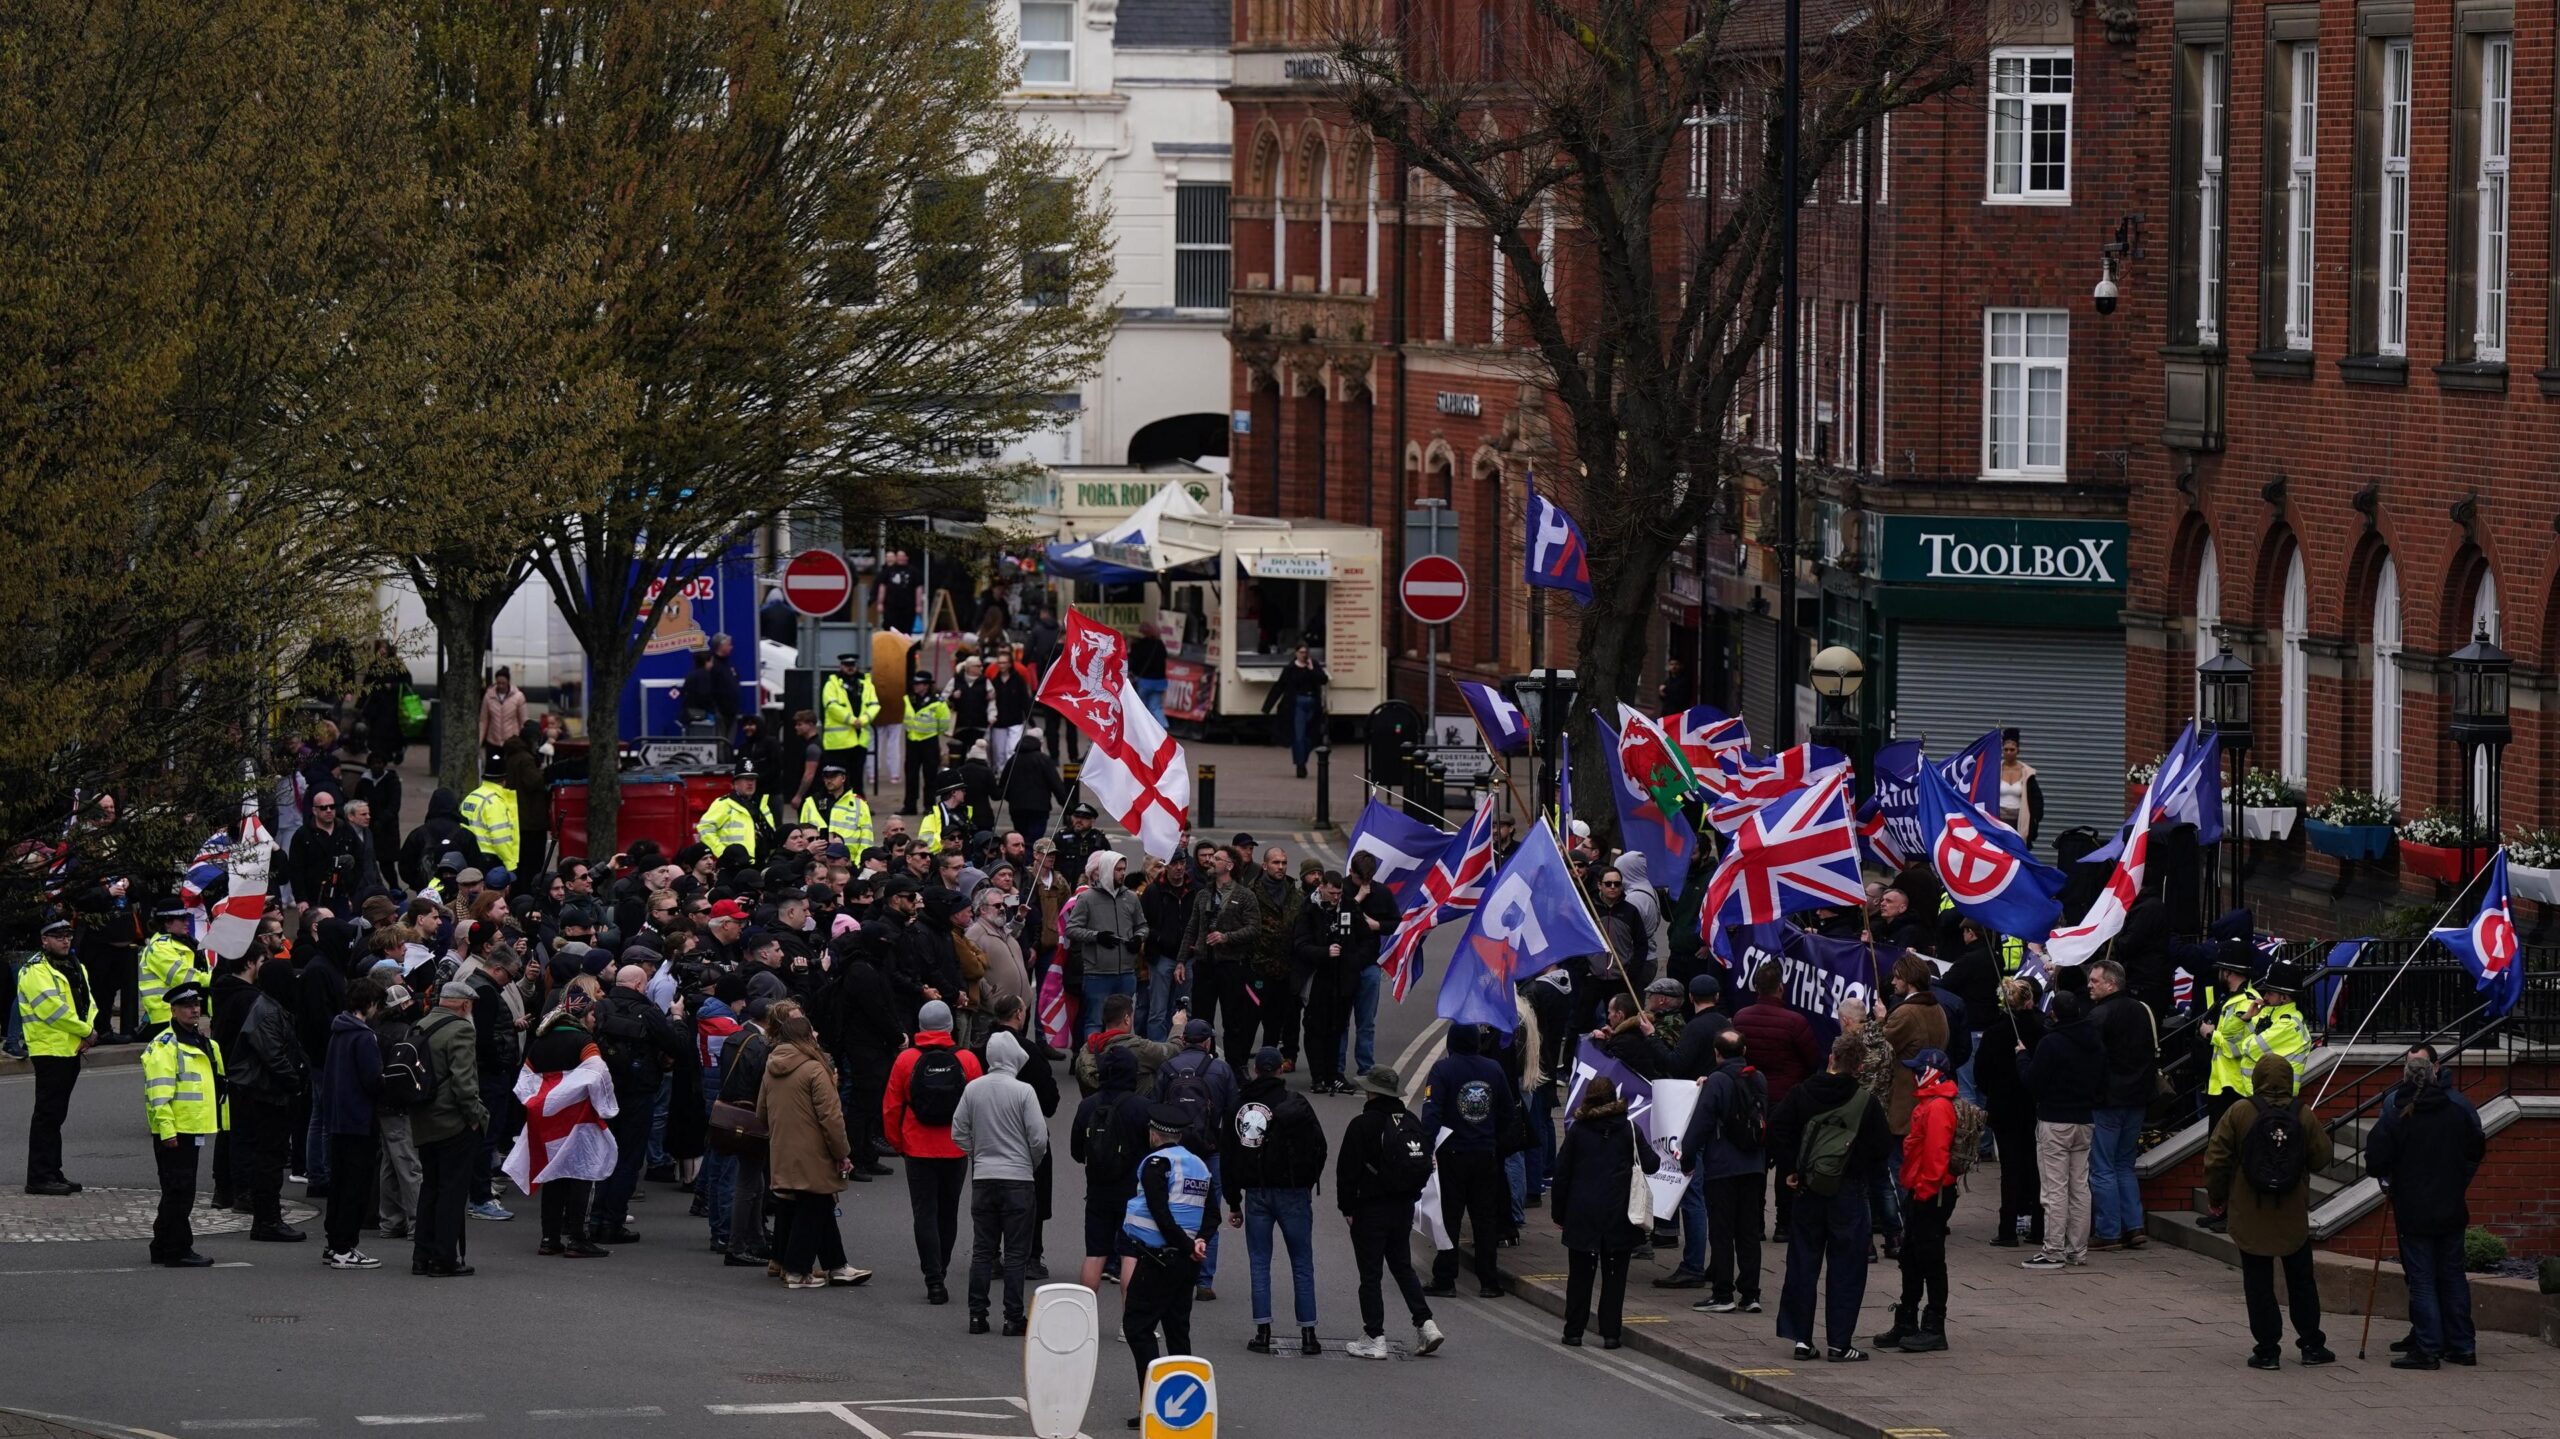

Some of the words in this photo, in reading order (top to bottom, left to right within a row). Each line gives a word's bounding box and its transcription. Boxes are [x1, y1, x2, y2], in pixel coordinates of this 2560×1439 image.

[1077, 483, 1118, 506] PORK
[1121, 484, 1166, 506] ROLL
[1290, 558, 1318, 567] NUTS
[1919, 532, 2116, 583] TOOLBOX
[1261, 567, 1280, 575] TEA
[1285, 567, 1326, 577] COFFEE
[1113, 606, 1140, 624] PORK
[1736, 945, 1793, 993] STP
[1791, 959, 1828, 1015] THE
[1184, 1179, 1209, 1191] POLICE
